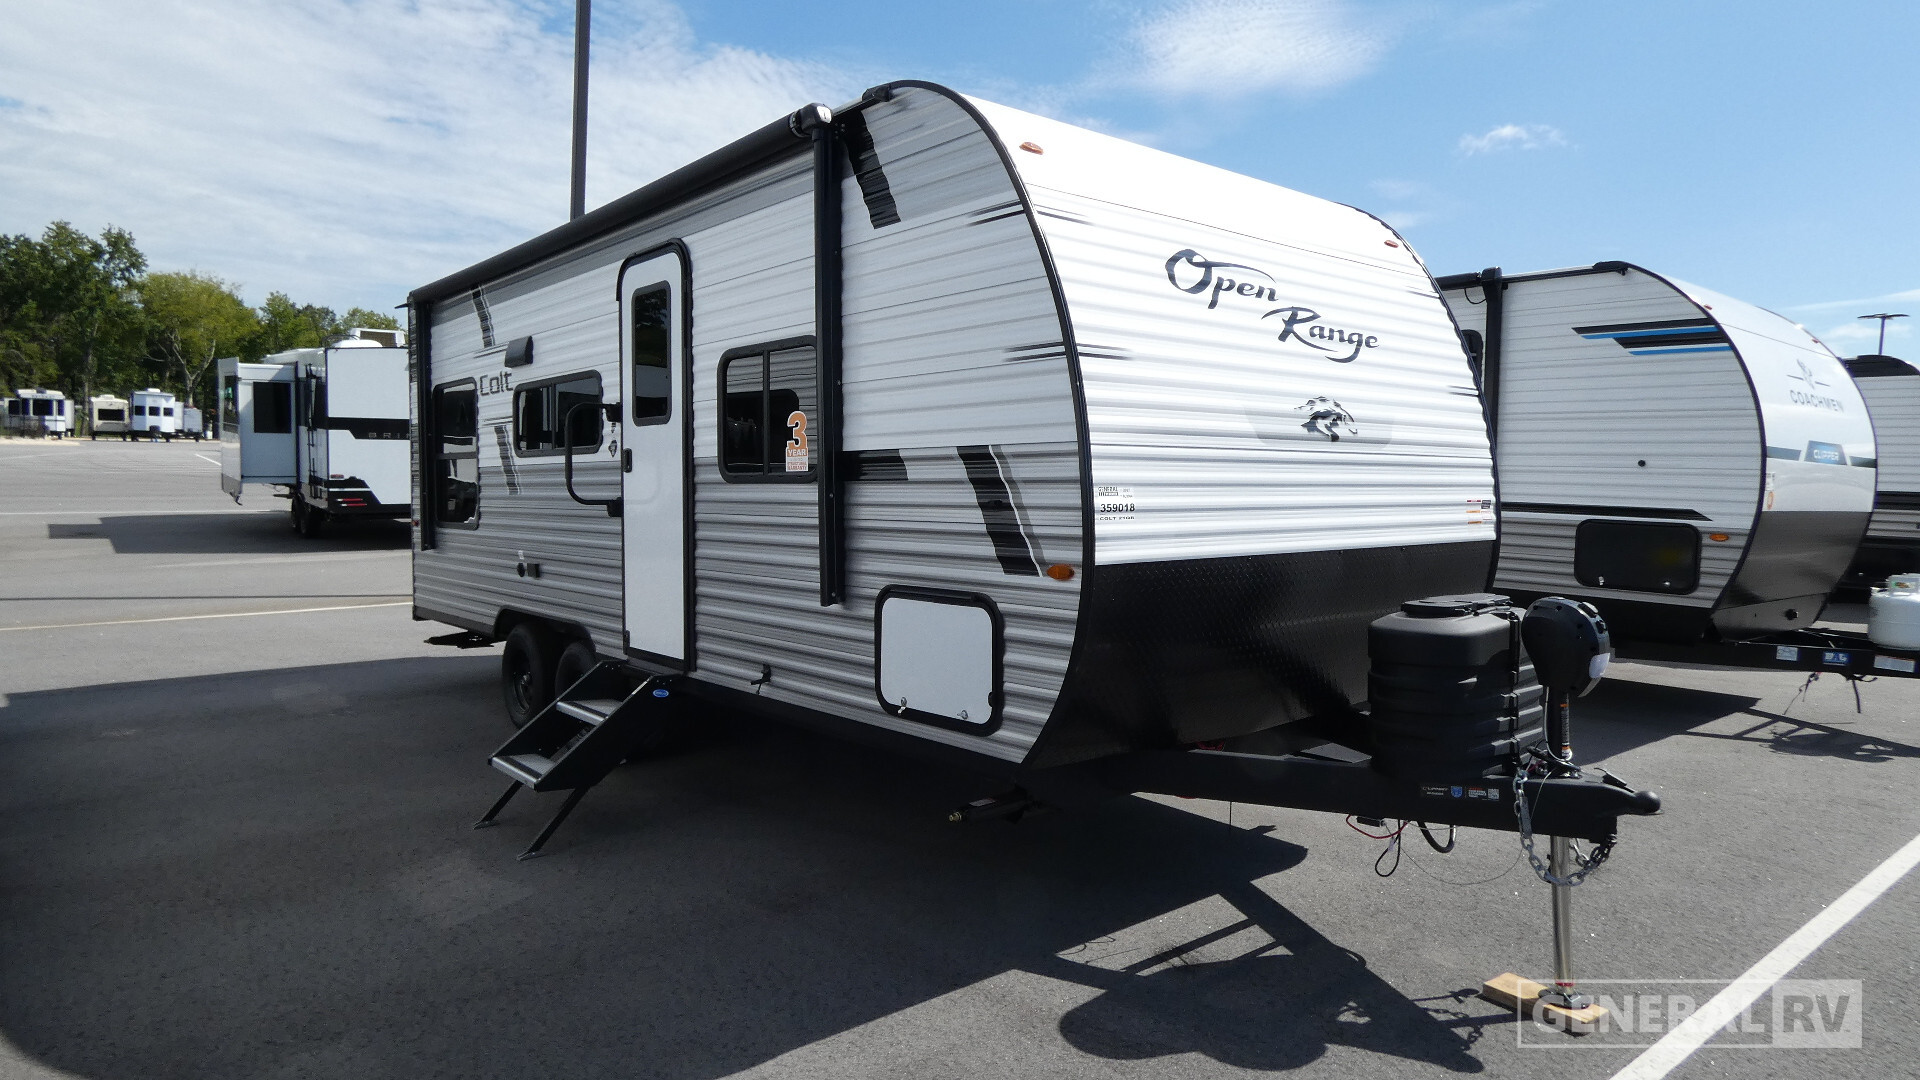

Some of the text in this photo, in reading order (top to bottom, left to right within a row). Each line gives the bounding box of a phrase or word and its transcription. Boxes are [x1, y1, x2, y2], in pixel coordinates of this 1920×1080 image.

[1165, 248, 1279, 310] Open
[1261, 306, 1380, 364] Range
[479, 370, 514, 397] Colt
[1789, 389, 1844, 413] COACHMEN
[787, 411, 807, 448] 3
[1813, 449, 1840, 462] CLIPPER
[1100, 503, 1135, 512] 359018
